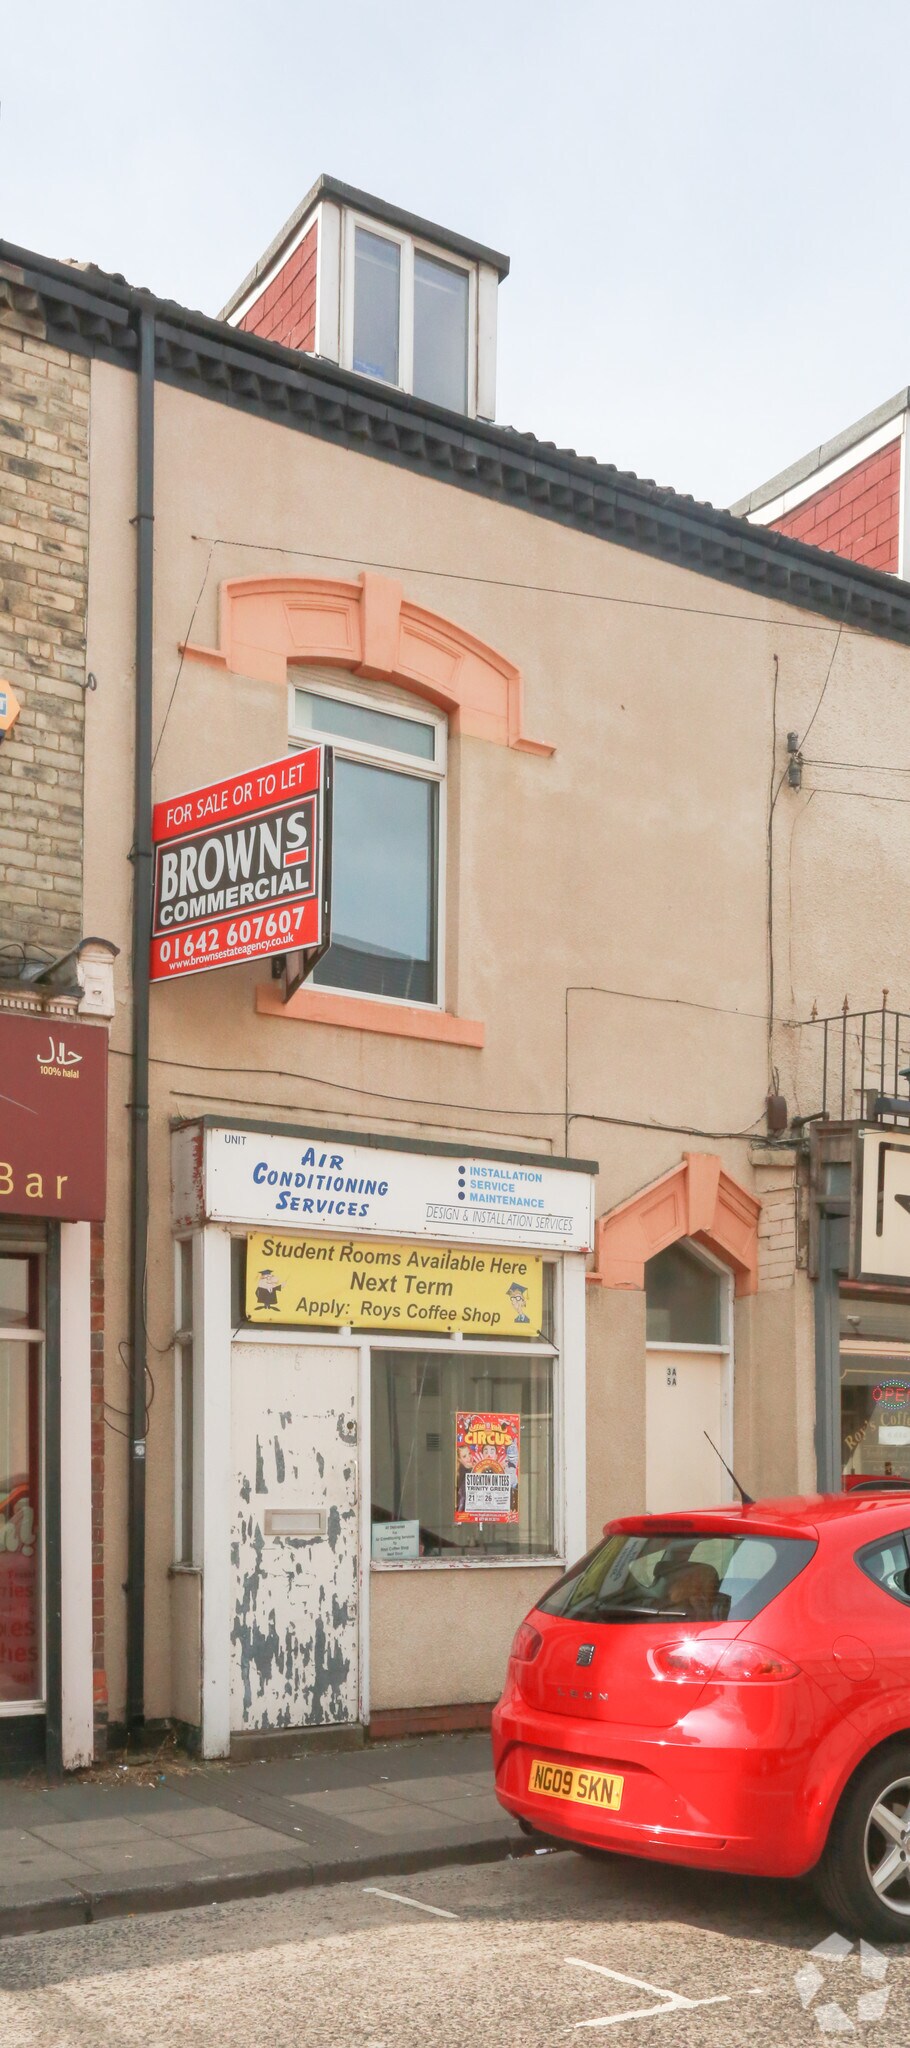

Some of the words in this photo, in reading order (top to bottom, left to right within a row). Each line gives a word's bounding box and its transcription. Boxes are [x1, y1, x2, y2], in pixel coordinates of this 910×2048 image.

[166, 803, 193, 829] FOR
[196, 790, 229, 820] SALE
[232, 782, 253, 806] OR
[257, 774, 276, 798] TO
[281, 763, 306, 791] LET
[160, 811, 307, 903] BROWNS
[160, 869, 310, 926] COMMERCIAL
[159, 928, 220, 963] 01642
[226, 906, 305, 947] 607607
[169, 932, 294, 971] www.brownsestateagency.co.uk
[36, 1036, 83, 1066] حلال
[40, 1065, 62, 1077] 100%
[62, 1068, 80, 1079] halal
[224, 1134, 247, 1146] UNIT
[469, 1166, 543, 1183] INSTALLATION
[470, 1180, 515, 1193] SERVICE
[469, 1192, 545, 1209] MAINTENANCE
[426, 1205, 460, 1221] DESIGN
[462, 1209, 469, 1222] &
[472, 1210, 533, 1228] INSTALLATION
[535, 1215, 573, 1232] SERVICES
[261, 1239, 335, 1261] Student
[339, 1244, 402, 1266] Rooms
[406, 1250, 485, 1272] Available
[490, 1257, 528, 1276] Here
[350, 1271, 398, 1293] Next
[404, 1274, 453, 1297] Term
[295, 1296, 351, 1318] Apply:
[360, 1300, 401, 1321] Roys
[406, 1303, 457, 1321] Coffee
[461, 1306, 501, 1327] Shop
[666, 1367, 677, 1377] 3A
[666, 1377, 677, 1387] 5A
[464, 1430, 512, 1446] CIRCUS
[466, 1474, 490, 1486] STOCKTON
[491, 1475, 498, 1486] ON
[498, 1475, 510, 1487] TEES
[468, 1494, 475, 1502] 21
[484, 1494, 493, 1502] 26
[533, 1764, 574, 1796] NG09
[576, 1773, 614, 1804] SKN
